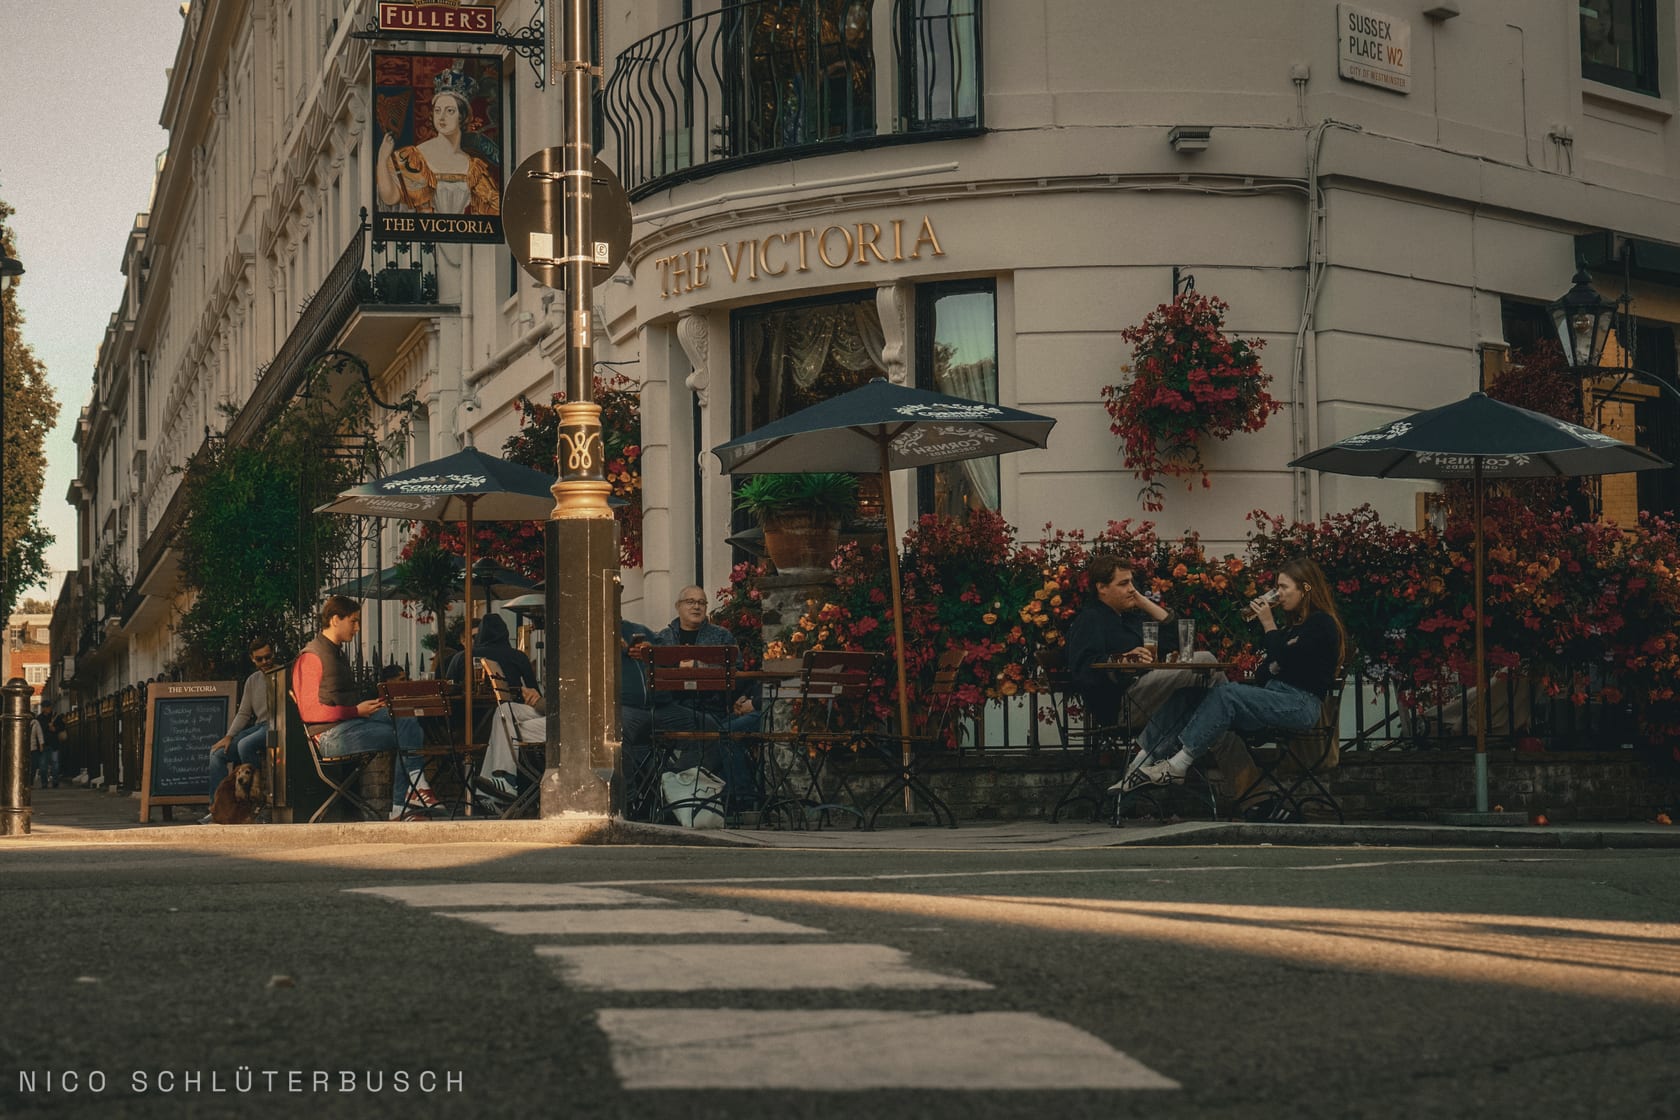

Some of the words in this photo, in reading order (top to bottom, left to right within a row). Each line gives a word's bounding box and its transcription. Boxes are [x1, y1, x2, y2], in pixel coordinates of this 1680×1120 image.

[386, 7, 487, 30] FULLER'S
[1349, 12, 1391, 41] SUSSEX
[1349, 36, 1383, 61] PLACE
[1387, 45, 1404, 67] W2
[1349, 66, 1362, 76] CITY
[1362, 68, 1369, 78] OF
[1370, 70, 1406, 87] WESTMINSTER
[383, 218, 415, 231] THE
[419, 218, 494, 233] VICTORIA
[655, 247, 711, 299] THE
[718, 215, 946, 283] VICTORIA
[399, 483, 467, 491] CORNISH
[183, 685, 217, 693] VICTORIA
